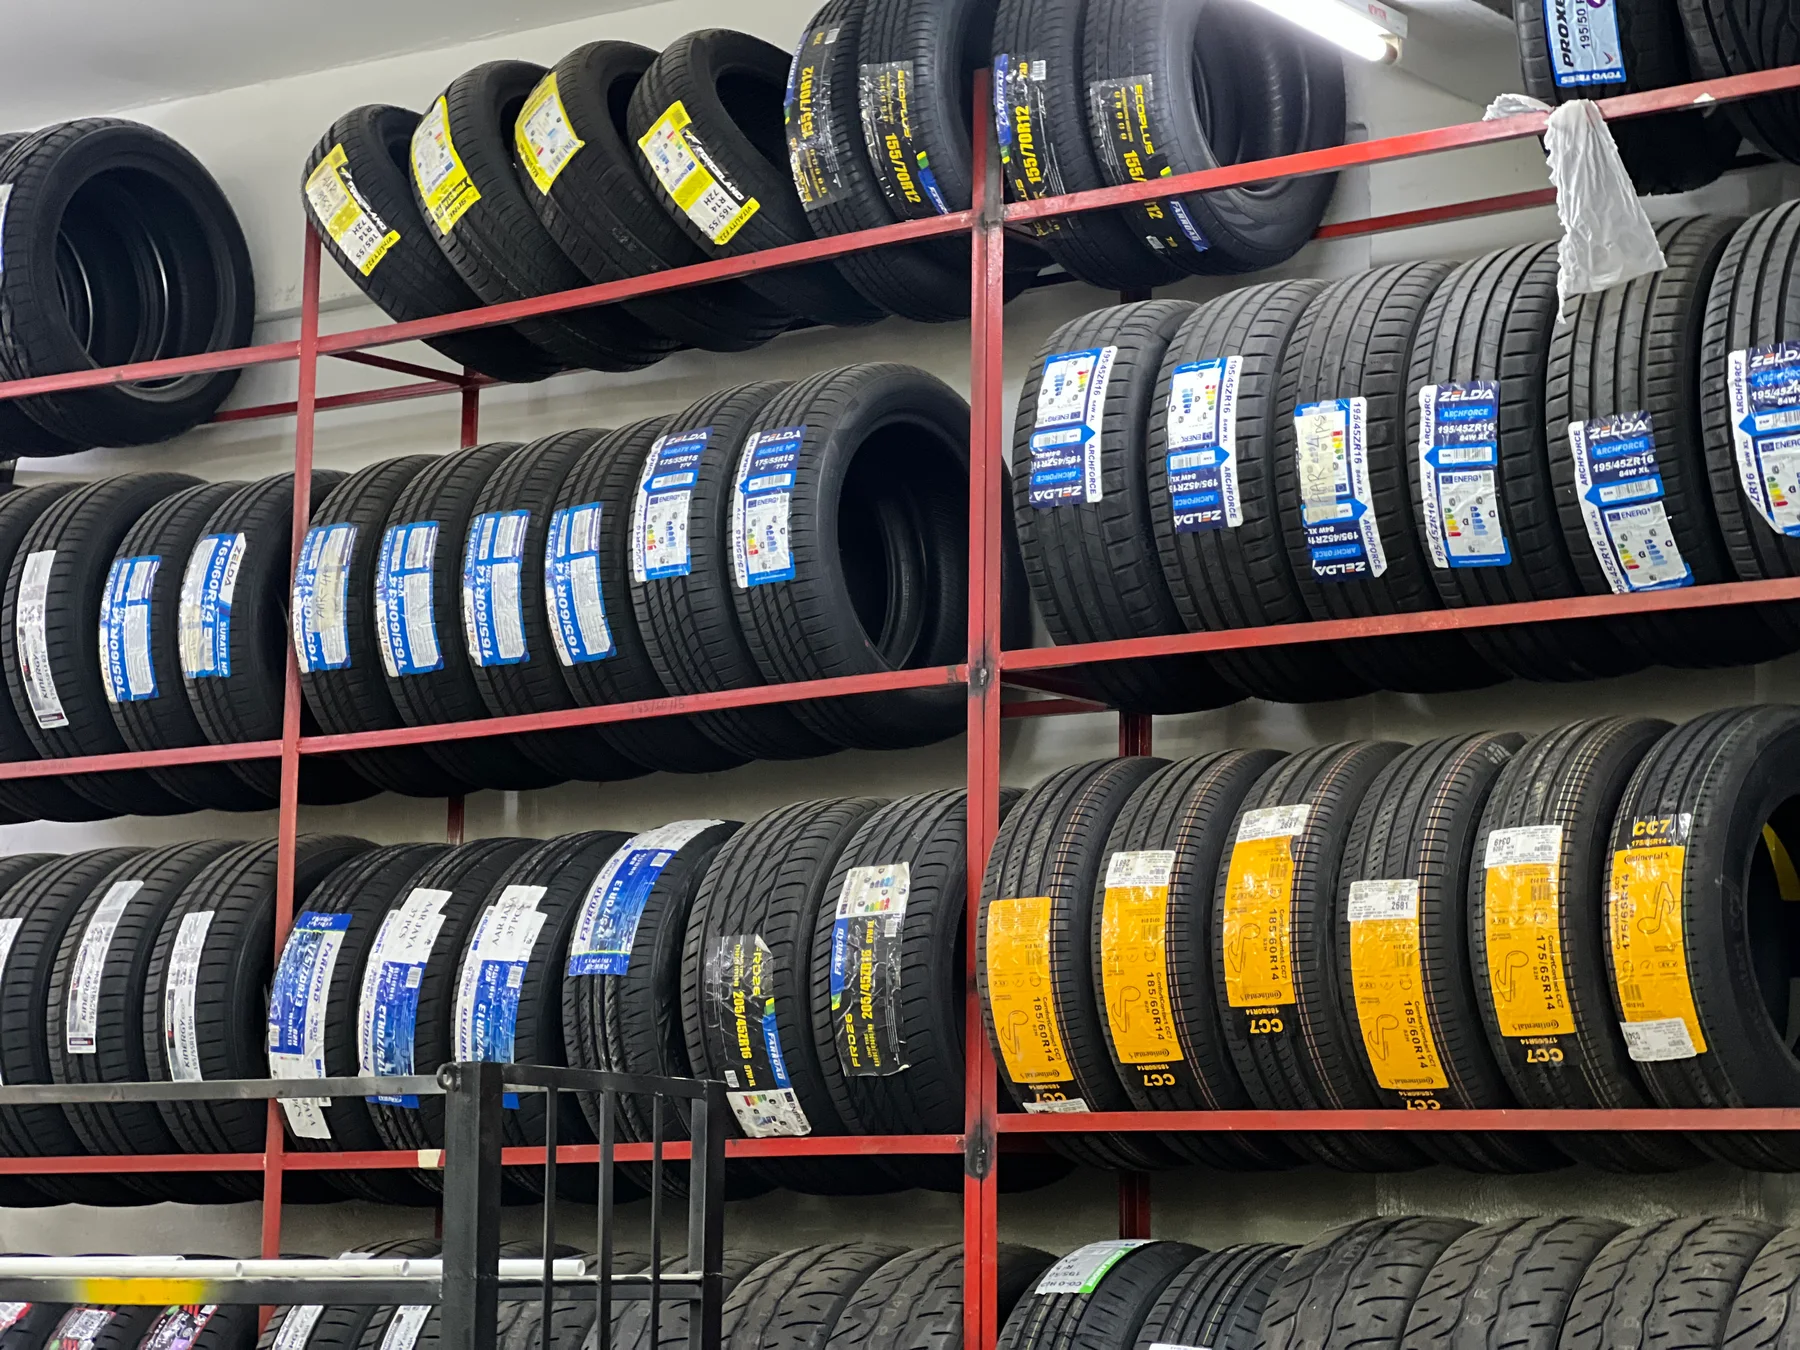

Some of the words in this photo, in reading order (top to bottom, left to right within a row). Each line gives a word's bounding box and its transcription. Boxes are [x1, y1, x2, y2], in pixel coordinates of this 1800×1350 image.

[1576, 8, 1591, 49] 195/50
[800, 65, 815, 139] 155/70R12
[1134, 83, 1155, 155] ECOPLUS
[1015, 105, 1042, 184] 155/70R12
[884, 132, 922, 203] 155/70R12
[703, 189, 720, 206] 72H
[711, 195, 726, 213] R14
[352, 219, 367, 235] 72H
[708, 205, 733, 231] 165/55
[730, 205, 753, 232] VITALITY
[356, 234, 378, 260] 165/55
[359, 226, 373, 242] R14
[1093, 349, 1112, 396] 195/45ZR16
[1223, 359, 1238, 413] 195/45ZR16
[1438, 389, 1494, 402] ZELDA
[1424, 393, 1432, 446] ARCHFORCE
[1443, 408, 1488, 418] ARCHFORCE
[665, 431, 707, 446] ZELDA
[758, 430, 801, 444] ZELDA
[1353, 402, 1363, 464] 195/45ZR16
[1437, 423, 1495, 434] 195/45ZR16
[1588, 421, 1648, 440] ZELDA
[659, 454, 698, 466] 175/55R15
[754, 454, 794, 467] 175/55R15
[1573, 430, 1588, 486] ARCHFORCE
[1596, 441, 1645, 455] ARCHFORCE
[1088, 443, 1097, 495] ARCHFORCE
[1592, 455, 1654, 473] 195/45ZR16
[1619, 468, 1638, 477] 84W
[1639, 466, 1649, 474] XL
[1033, 485, 1083, 501] ZELDA
[1224, 466, 1237, 519] ARCHFORCE
[552, 514, 558, 526] HP
[1174, 509, 1222, 526] ZELDA
[467, 532, 478, 568] SURATE
[474, 518, 481, 530] HP
[1363, 519, 1382, 570] ARCHFORCE
[206, 539, 231, 623] 165/60R14
[225, 546, 243, 587] ZELDA
[1314, 561, 1366, 576] ZELDA
[388, 573, 408, 669] 165/60R14
[474, 564, 494, 659] 165/60R14
[556, 561, 581, 656] 165/60R14
[219, 621, 227, 658] SURATE
[33, 655, 48, 699] KINERGY
[222, 661, 229, 674] HP
[1633, 819, 1671, 836] CC7
[1624, 852, 1664, 865] Continental
[411, 907, 419, 918] 37
[418, 900, 434, 921] AAR
[579, 885, 603, 942] FARROAD
[1620, 873, 1630, 951] 175/65R14
[397, 917, 413, 940] PCS
[405, 921, 422, 950] JAYA
[491, 922, 505, 947] AAR
[506, 925, 515, 937] 37
[1268, 908, 1280, 981] 185/60R14
[310, 942, 333, 1004] FARROAD
[859, 948, 873, 1020] 205/45ZR16
[1536, 934, 1556, 1011] 175/65R14
[1547, 934, 1559, 992] ComfortContact
[1555, 992, 1564, 1008] CC7
[81, 973, 94, 1021] KINERGY
[1146, 971, 1165, 1041] 185/60R14
[1155, 971, 1169, 1023] ComfortContact
[1164, 1024, 1173, 1039] CC7
[1246, 989, 1282, 1000] Continental
[377, 1004, 387, 1074] 175/70R13
[732, 991, 753, 1060] 205/45ZR16
[1033, 996, 1055, 1062] 185/60R14
[1249, 1018, 1284, 1034] CC7
[1403, 1000, 1428, 1069] 185/60R14
[1414, 1000, 1432, 1055] ComfortContact
[1427, 1053, 1437, 1067] CC7
[1524, 1019, 1559, 1031] Continental
[179, 1021, 190, 1068] KINERGY
[844, 1012, 861, 1068] FRD26
[1053, 1046, 1062, 1061] CC7
[1133, 1048, 1170, 1058] Continental
[767, 1032, 785, 1081] FARROAD
[1526, 1047, 1564, 1063] CC7
[1143, 1073, 1176, 1087] CC7
[1400, 1076, 1434, 1085] Continental
[1406, 1099, 1441, 1111] CC7
